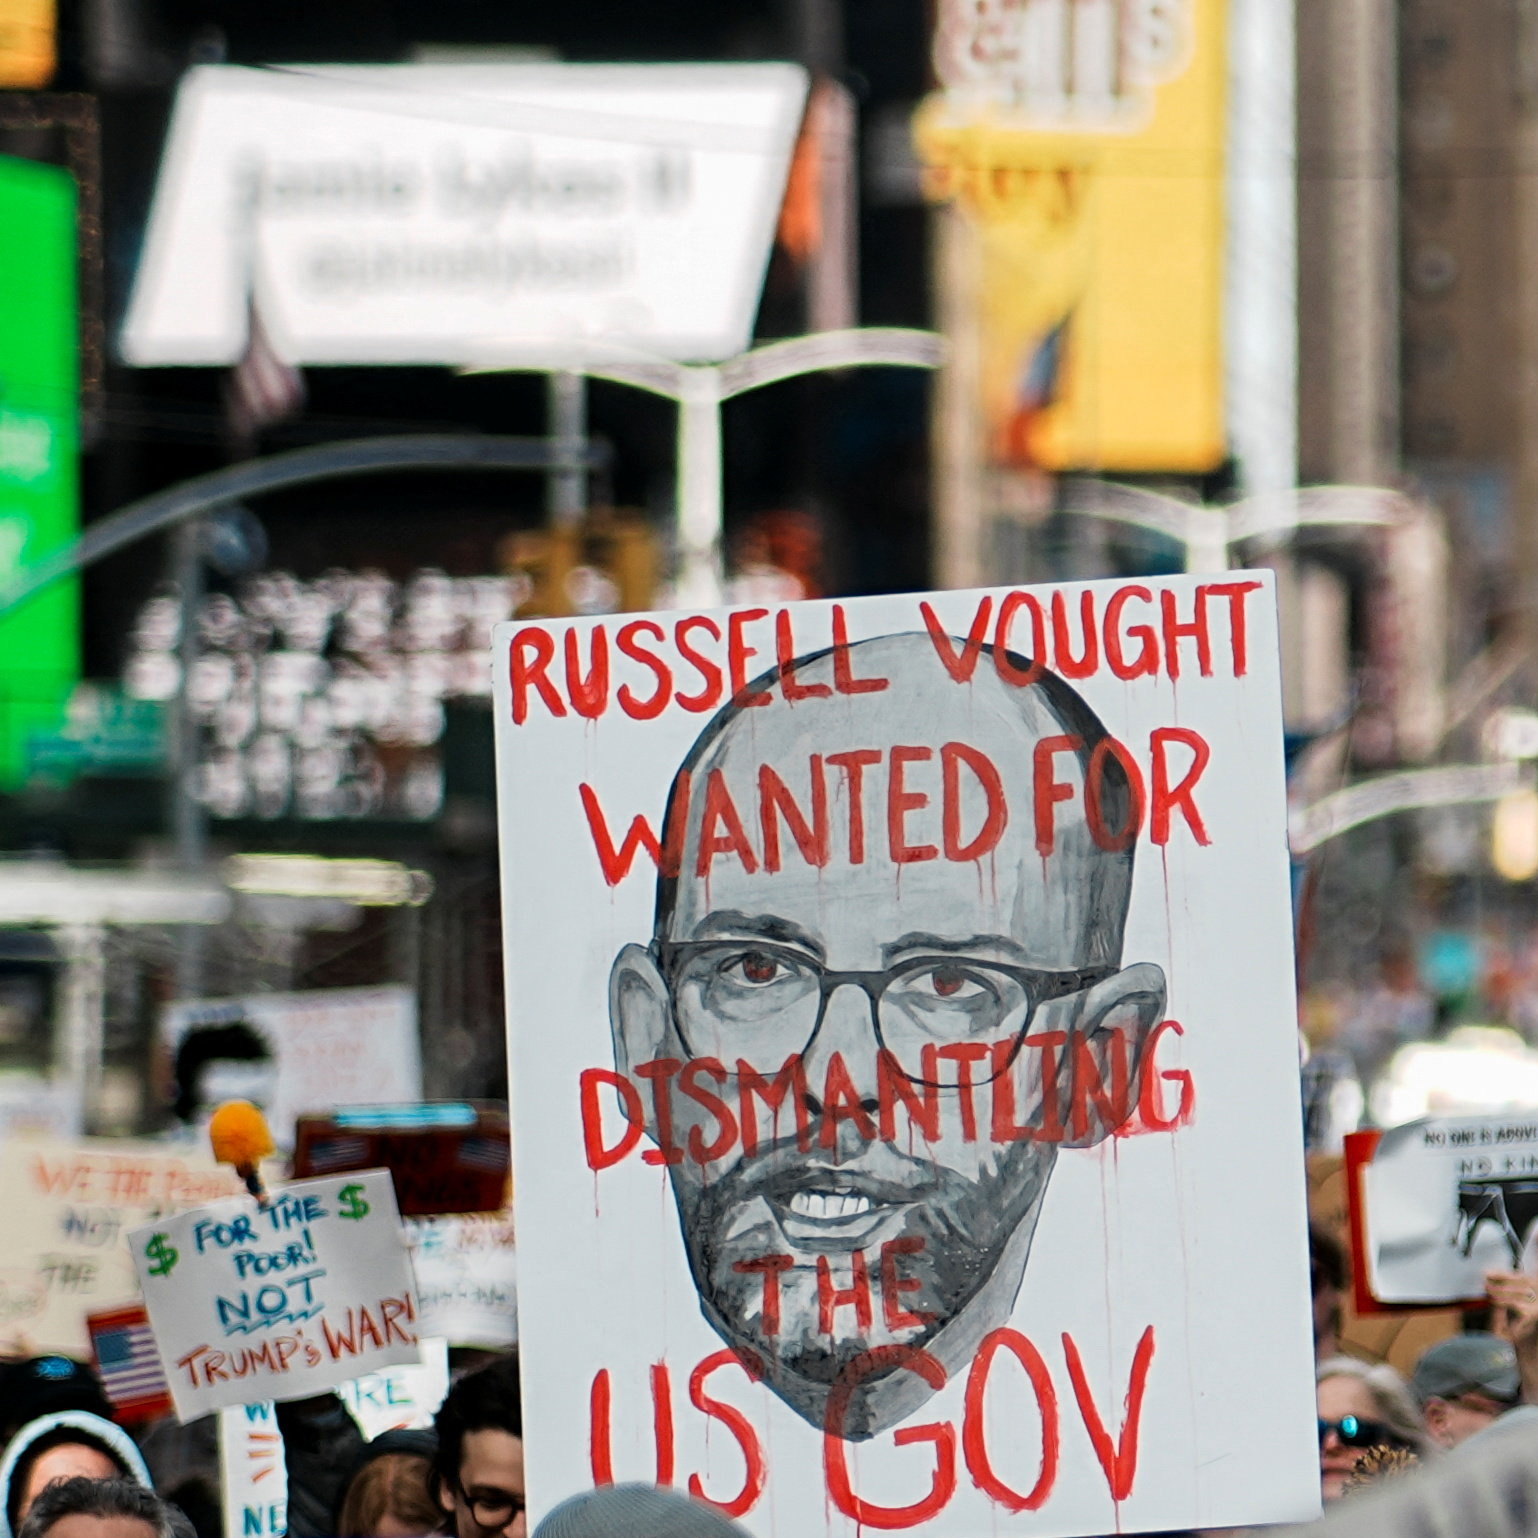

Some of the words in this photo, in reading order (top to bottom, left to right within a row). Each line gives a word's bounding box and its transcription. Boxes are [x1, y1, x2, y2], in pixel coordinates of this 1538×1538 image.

[510, 605, 890, 725] RUSSELL
[920, 579, 1264, 687] VOUGHT
[579, 741, 1008, 887] WANTED
[1032, 726, 1213, 858] FOR
[579, 1020, 1194, 1170] DISMANTLING
[1496, 1125, 1537, 1142] ABOVE
[193, 1214, 258, 1254] FOR
[259, 1194, 328, 1231] THE
[234, 1228, 317, 1279] POOR!
[216, 1268, 326, 1325] NOT
[321, 1290, 418, 1361] WAR!
[733, 1236, 935, 1336] THE
[589, 1345, 768, 1517] US
[823, 1323, 1155, 1529] GOV
